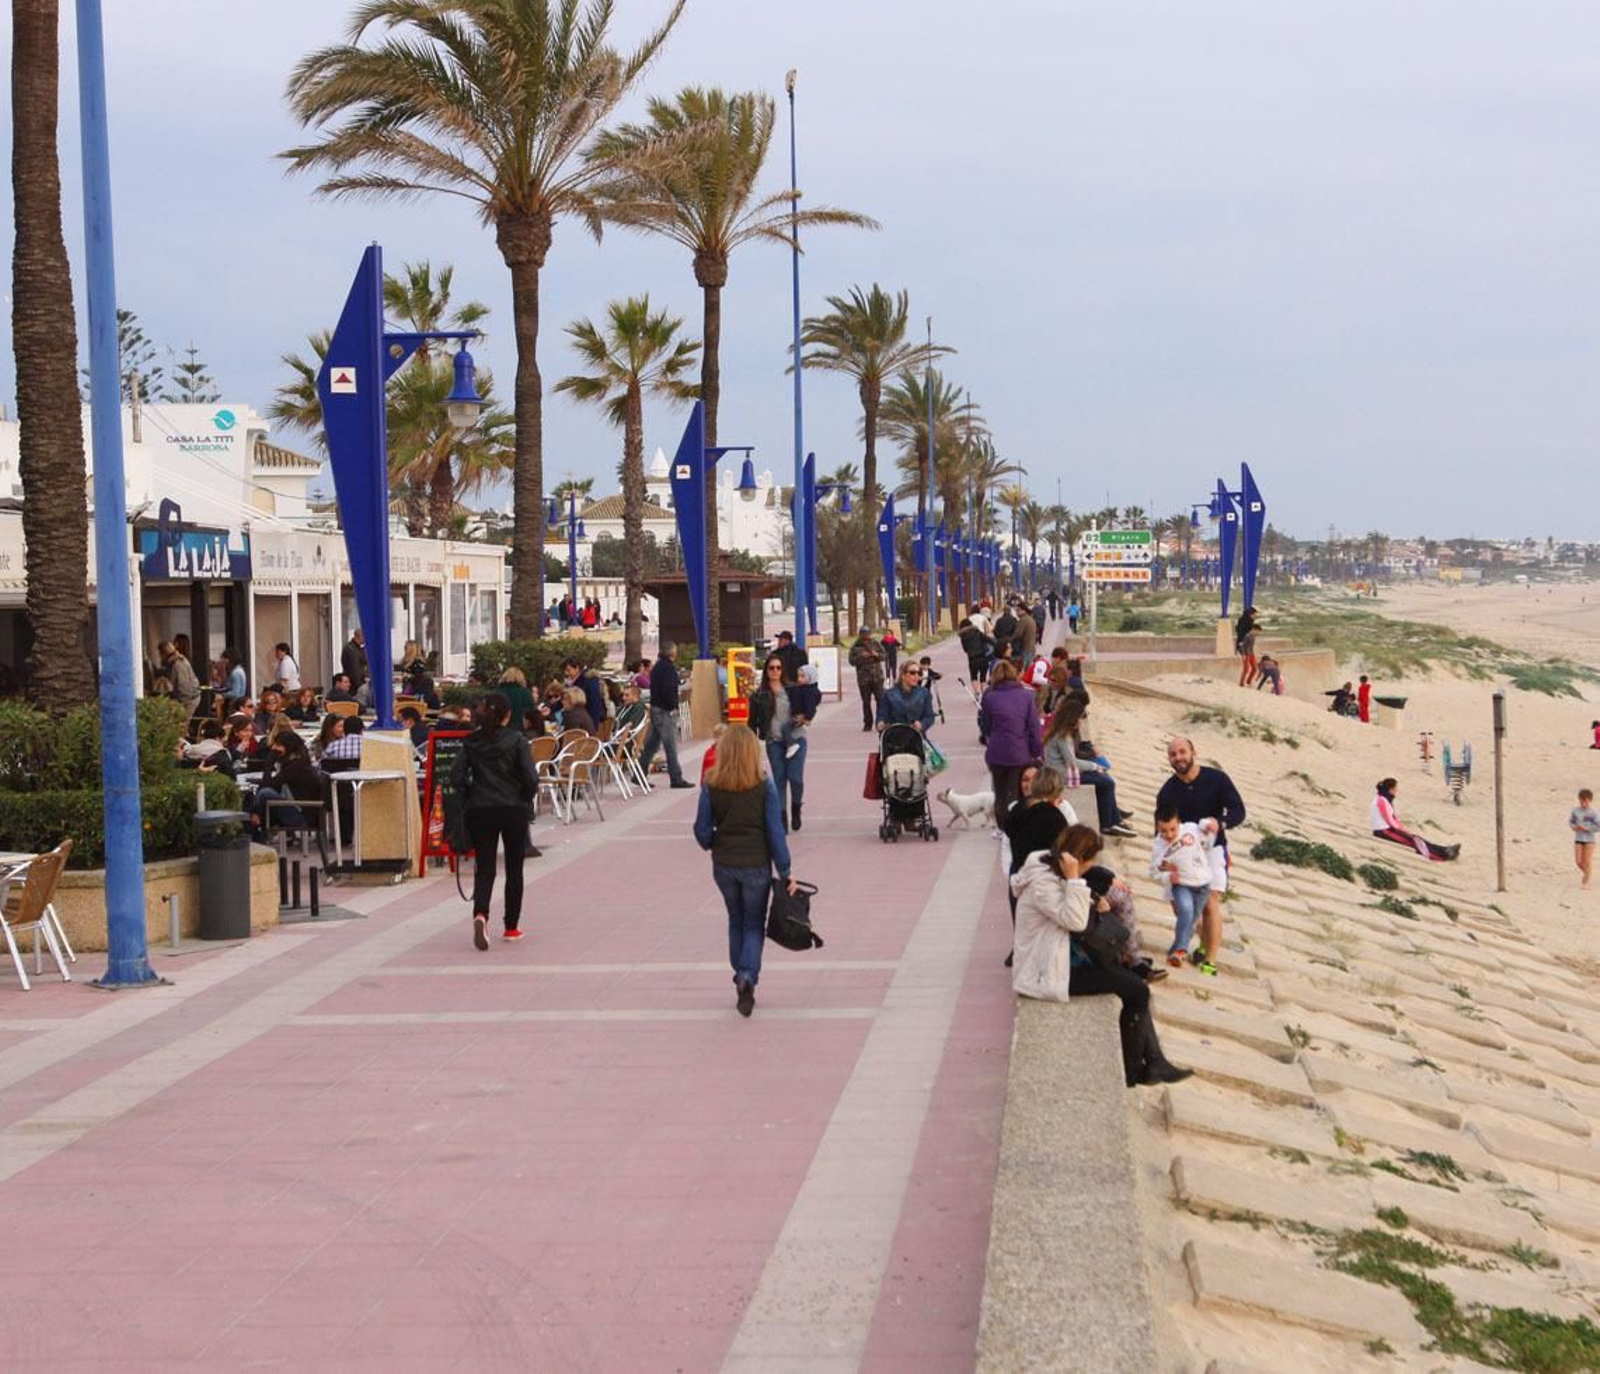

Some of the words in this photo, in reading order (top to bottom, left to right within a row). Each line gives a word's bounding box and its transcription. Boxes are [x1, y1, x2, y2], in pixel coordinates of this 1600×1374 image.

[166, 435, 194, 443] CASA
[196, 435, 211, 443] LA
[213, 435, 234, 443] TITI
[167, 542, 190, 578] LA
